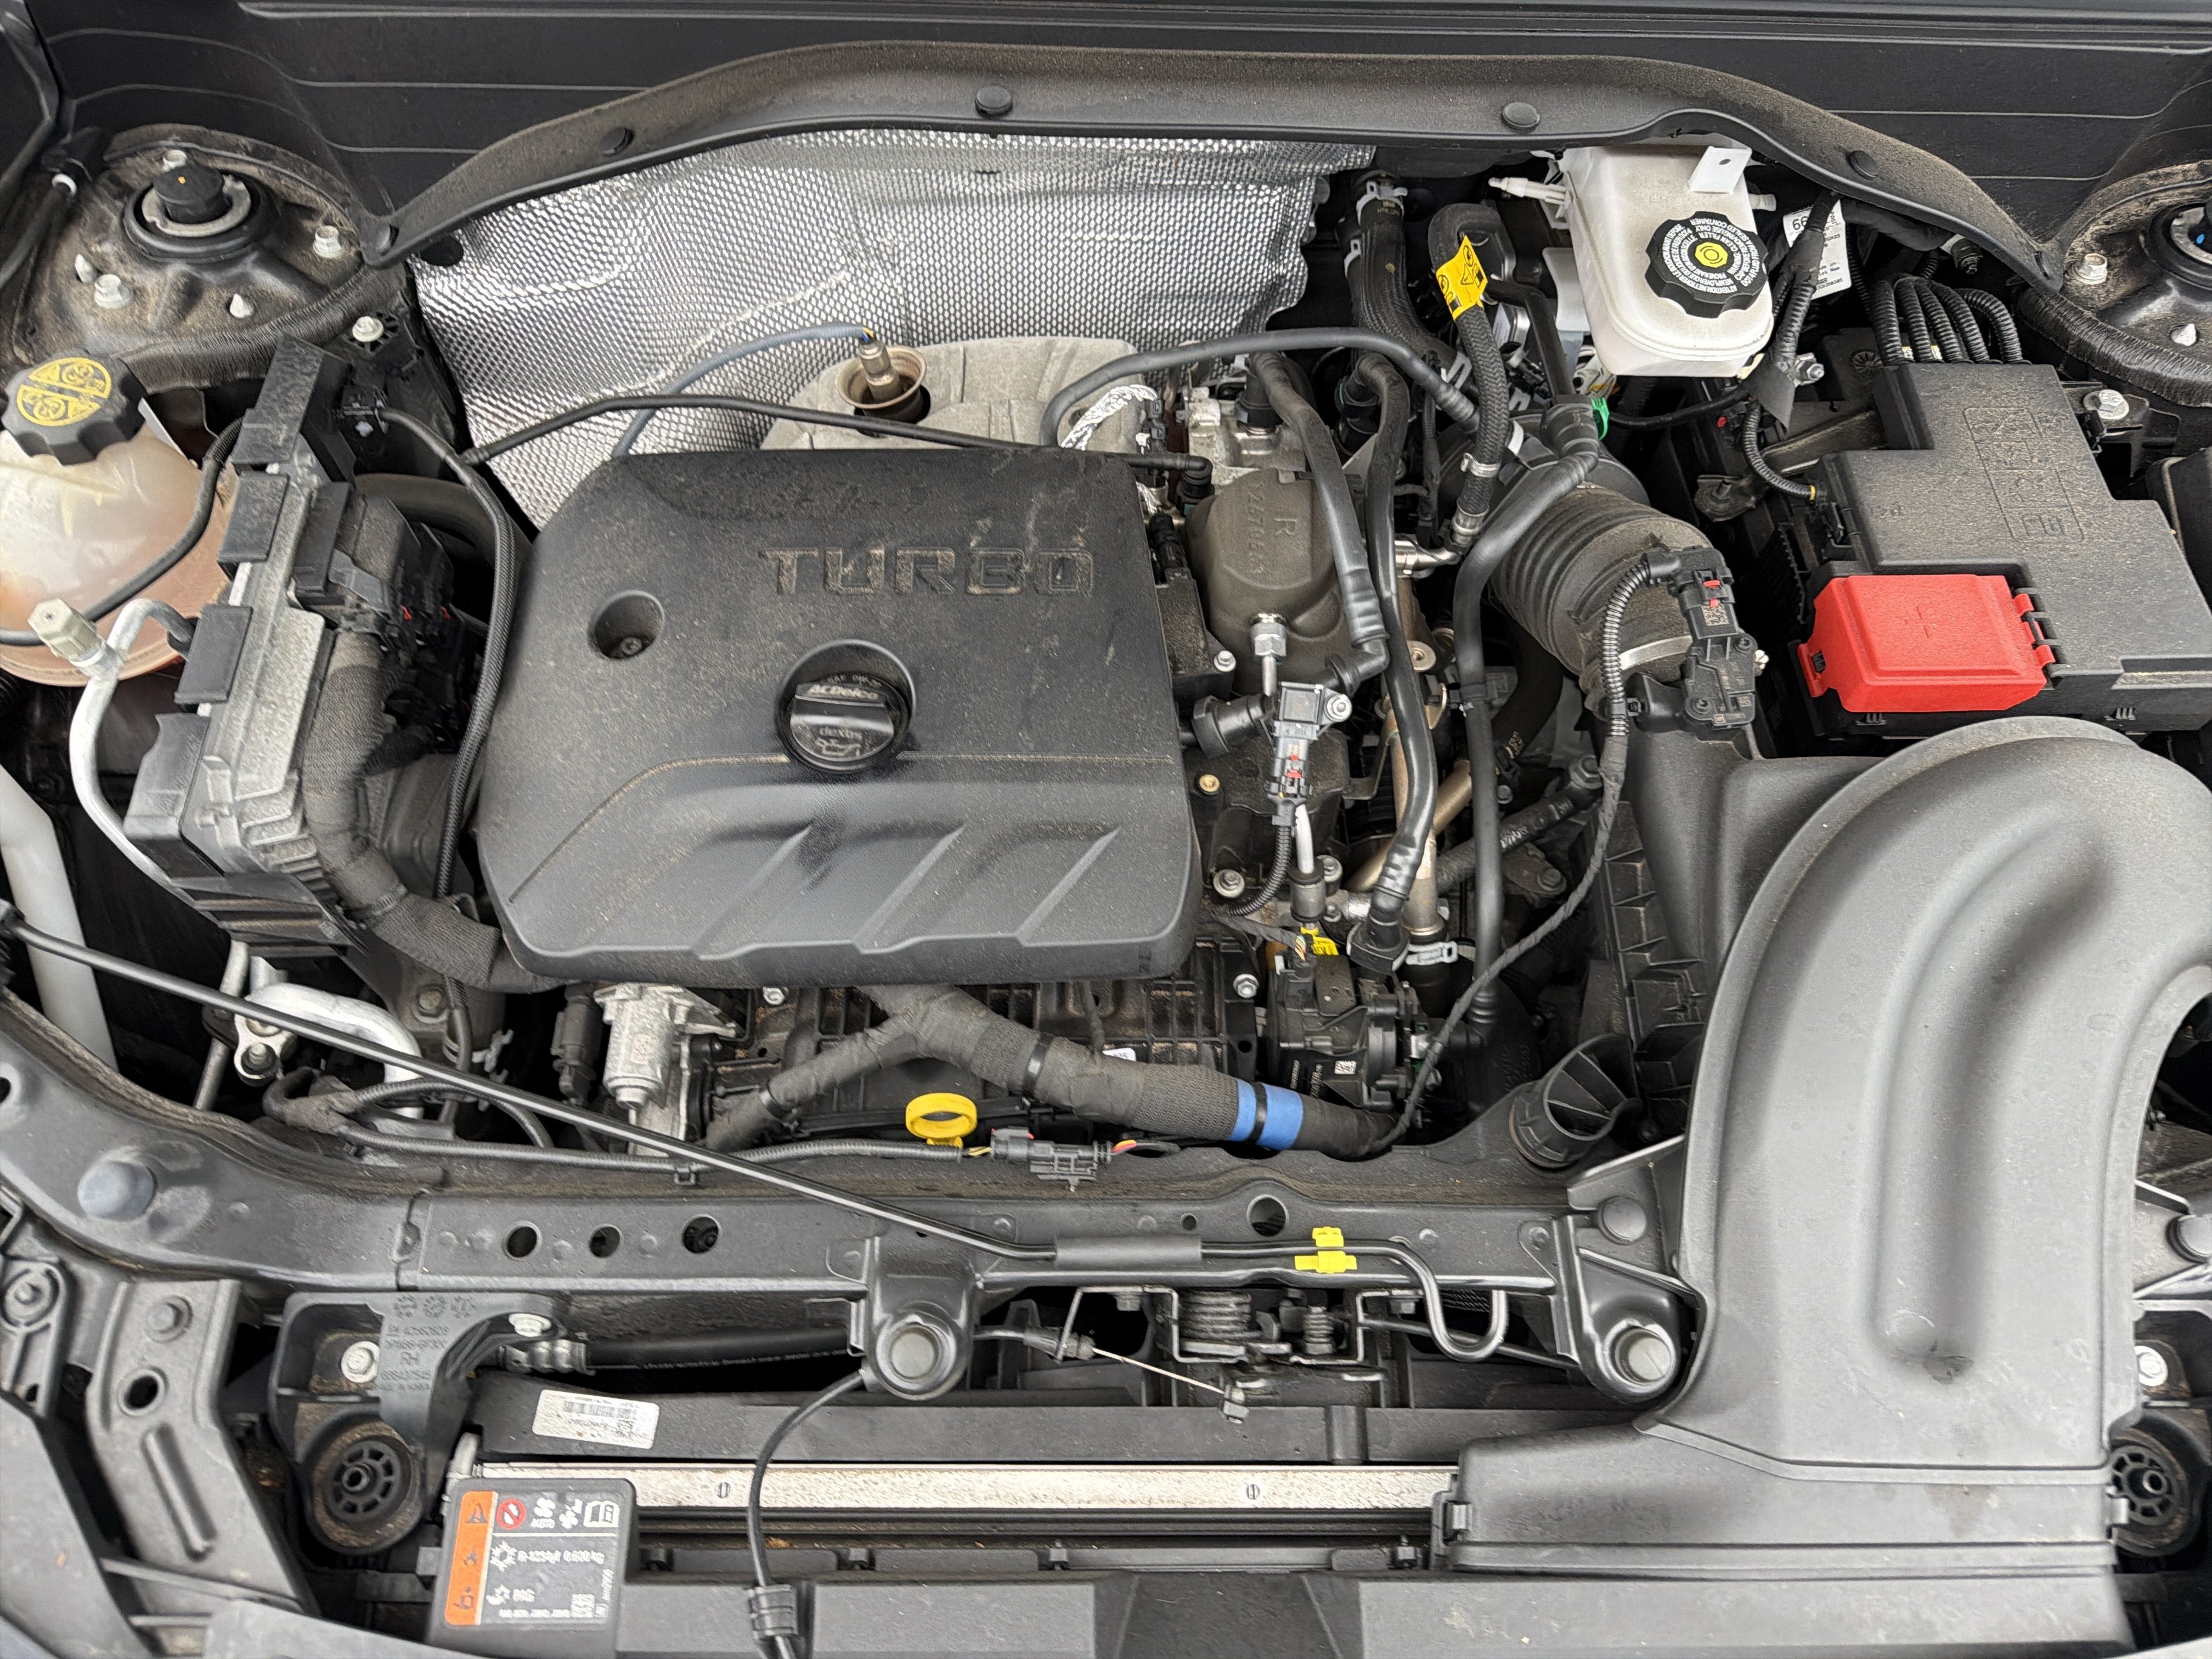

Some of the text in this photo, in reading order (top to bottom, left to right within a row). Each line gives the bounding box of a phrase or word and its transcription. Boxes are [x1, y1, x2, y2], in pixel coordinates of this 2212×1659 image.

[1690, 218, 1727, 228] CONTAINER
[1699, 231, 1720, 240] FILLER
[1727, 225, 1749, 241] SEALED
[1720, 236, 1738, 251] CLEAN
[1734, 270, 1745, 280] CAP
[1741, 253, 1751, 272] BEFORE
[760, 547, 1093, 596] TURBO
